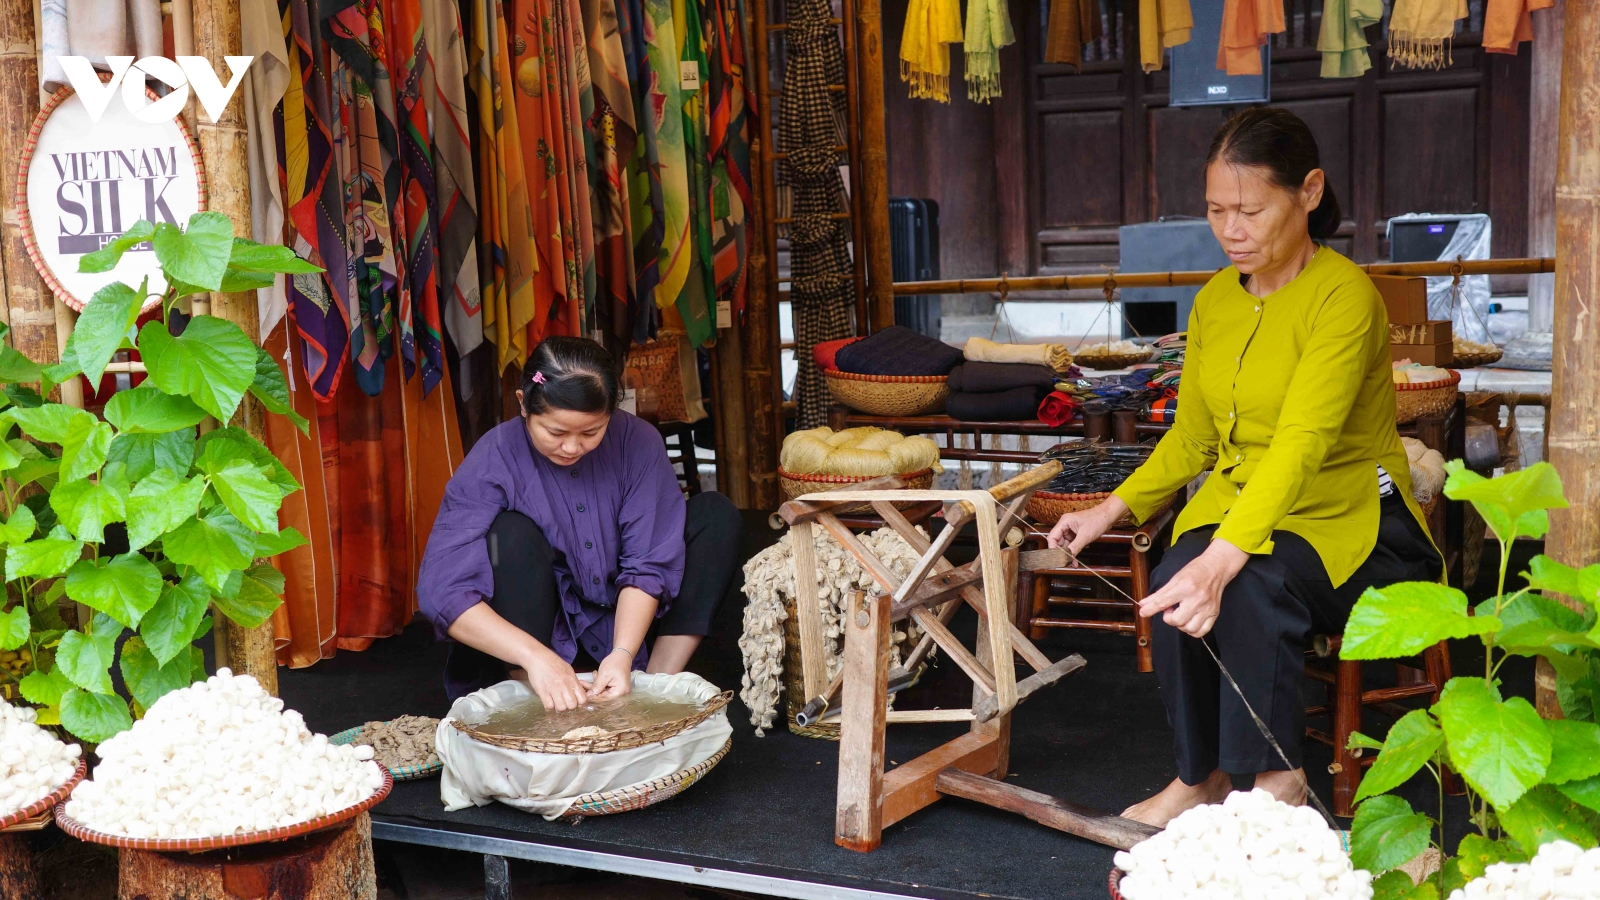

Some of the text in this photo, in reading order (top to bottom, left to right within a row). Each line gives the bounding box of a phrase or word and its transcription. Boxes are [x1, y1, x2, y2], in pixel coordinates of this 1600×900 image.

[1208, 86, 1227, 94] NEXO
[49, 146, 178, 182] VIETNAM
[56, 176, 184, 236] SILK
[99, 235, 148, 250] HSE
